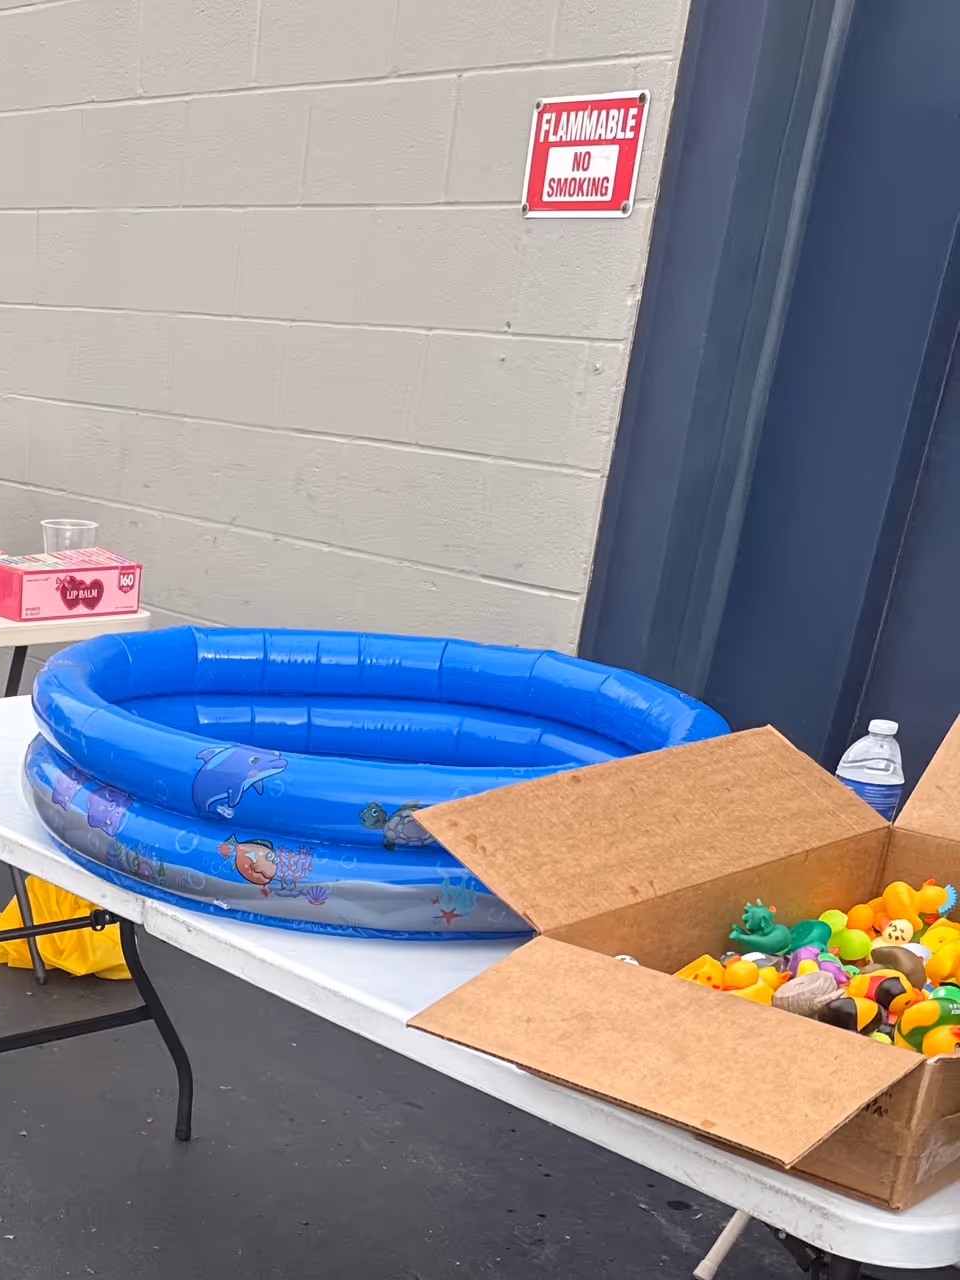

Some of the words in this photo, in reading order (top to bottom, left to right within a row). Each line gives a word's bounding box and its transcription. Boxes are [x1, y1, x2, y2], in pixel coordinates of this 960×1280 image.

[539, 108, 638, 143] FLAMMABLE
[571, 151, 592, 172] NO
[546, 176, 610, 198] SMOKING
[120, 574, 134, 586] 160
[66, 590, 78, 599] LIP
[79, 589, 98, 598] BALM
